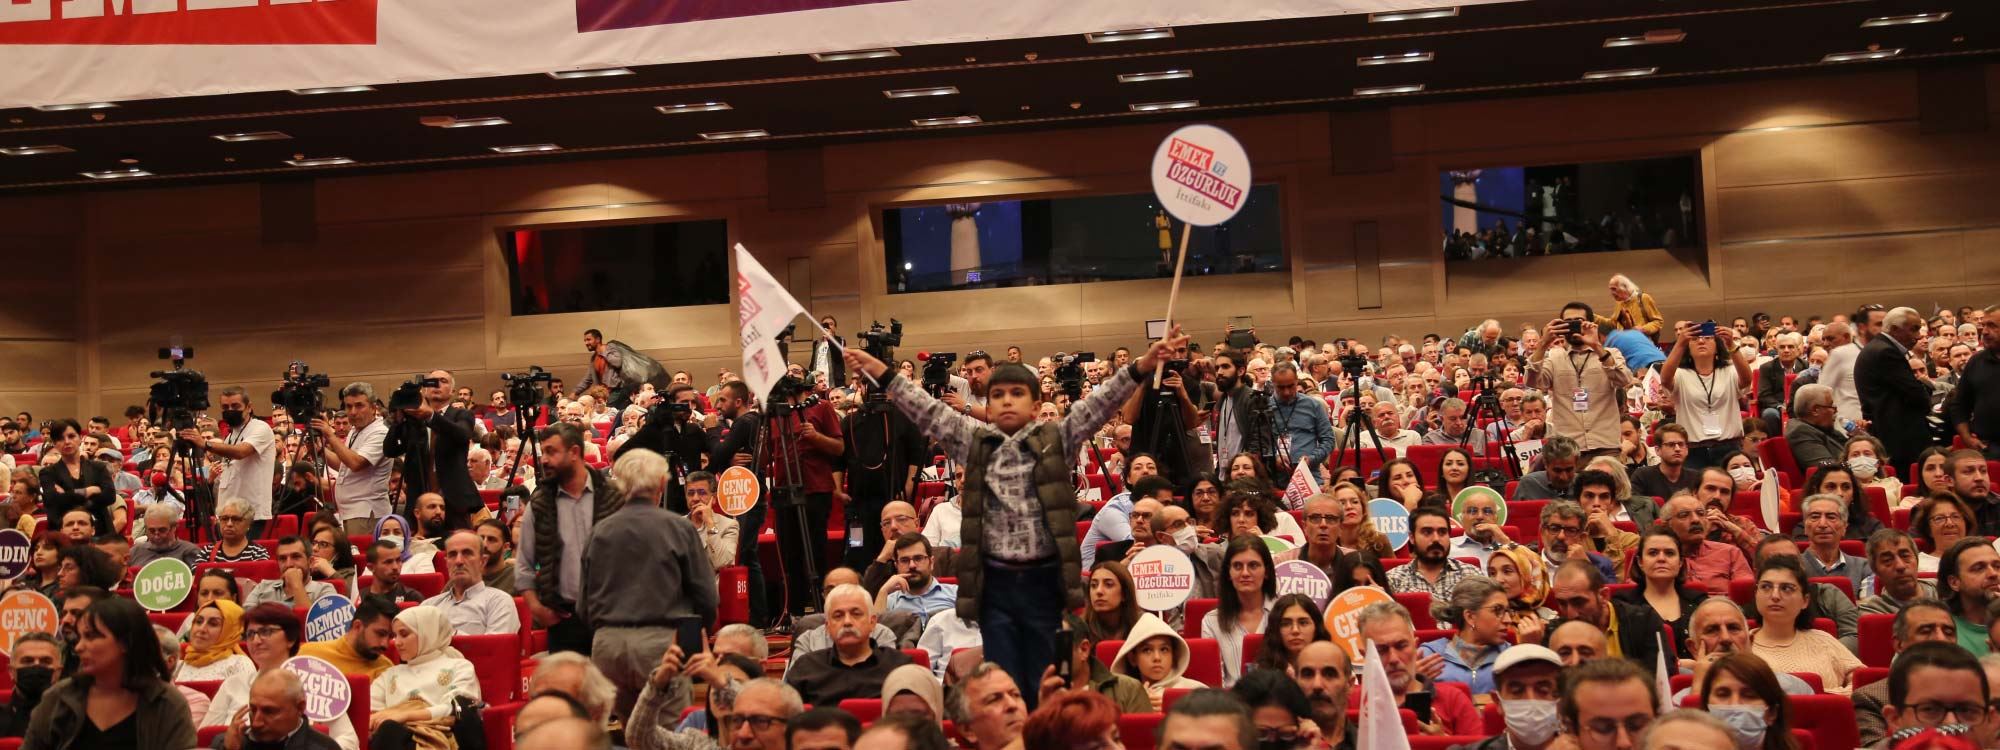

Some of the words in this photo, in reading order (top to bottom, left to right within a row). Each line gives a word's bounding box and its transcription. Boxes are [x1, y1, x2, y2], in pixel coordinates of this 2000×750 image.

[1170, 139, 1211, 170] EMEK
[1169, 160, 1238, 206] ÖZGÜRLÜK
[141, 570, 186, 596] DOĞA
[1133, 562, 1160, 576] EMEK
[2, 607, 48, 632] GENÇ
[306, 604, 354, 640] DEMOK
